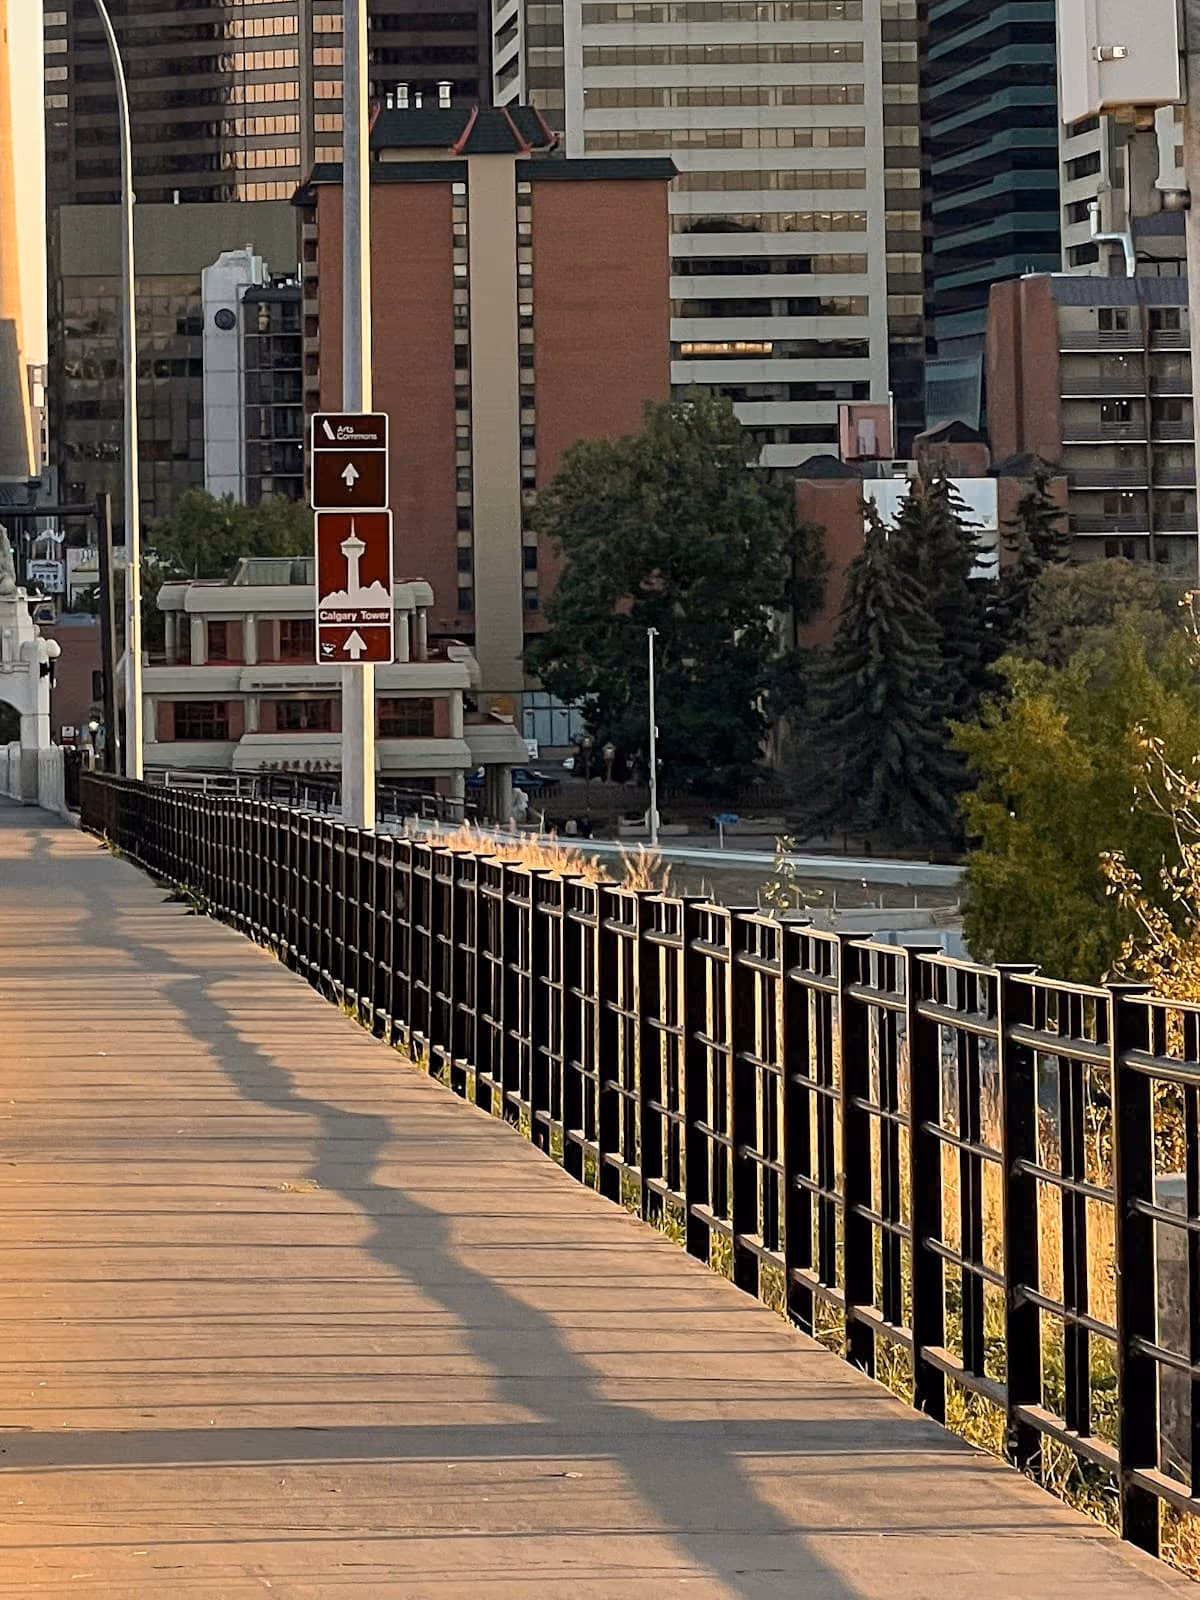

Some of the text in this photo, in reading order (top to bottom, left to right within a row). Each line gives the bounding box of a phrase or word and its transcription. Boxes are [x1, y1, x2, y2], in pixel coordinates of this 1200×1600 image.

[337, 425, 354, 433] Arts
[319, 611, 389, 621] Calgary Tower
